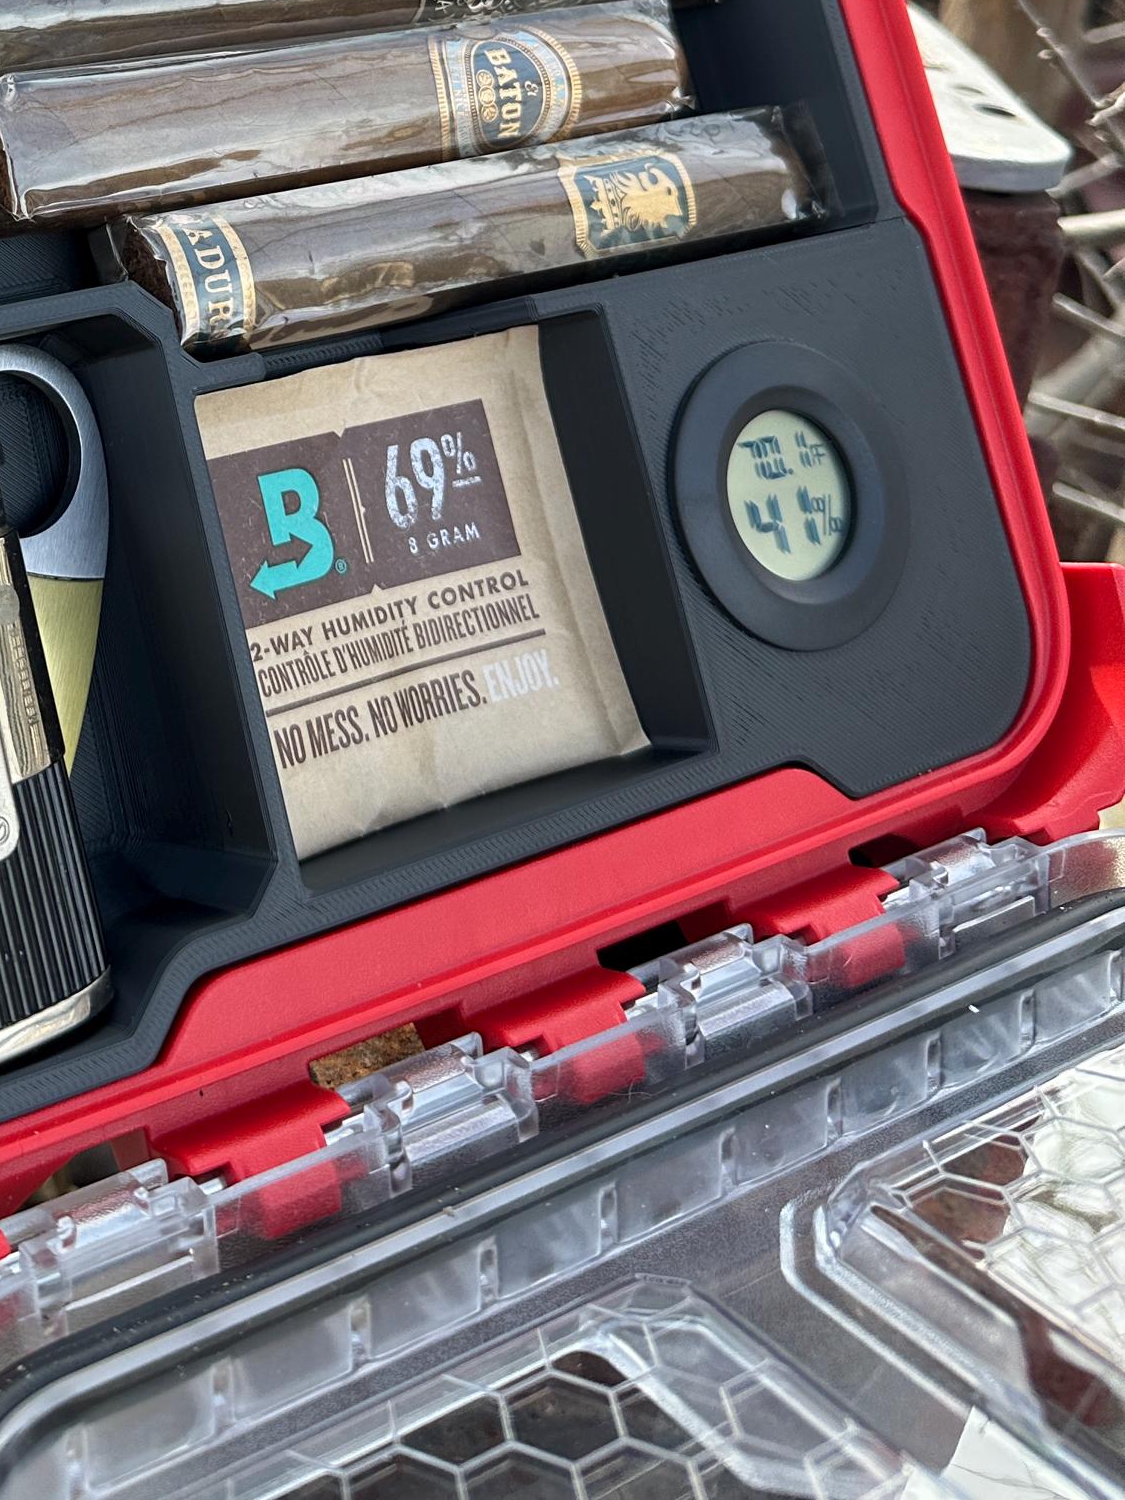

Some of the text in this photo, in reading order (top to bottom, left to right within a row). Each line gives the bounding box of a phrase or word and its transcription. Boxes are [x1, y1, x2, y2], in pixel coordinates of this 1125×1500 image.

[484, 47, 523, 140] BATON
[182, 227, 234, 327] ADUR
[384, 431, 477, 530] 69%
[408, 522, 481, 555] 8 GRAM
[250, 569, 529, 663] 2-WAY HUMIDITY CONTROL
[258, 593, 540, 699] CONTRÔLE D'HUMIDITÉ BIDIRECTIONNEL
[274, 649, 560, 770] NO MESS. NO WORRIES. ENJOY.
